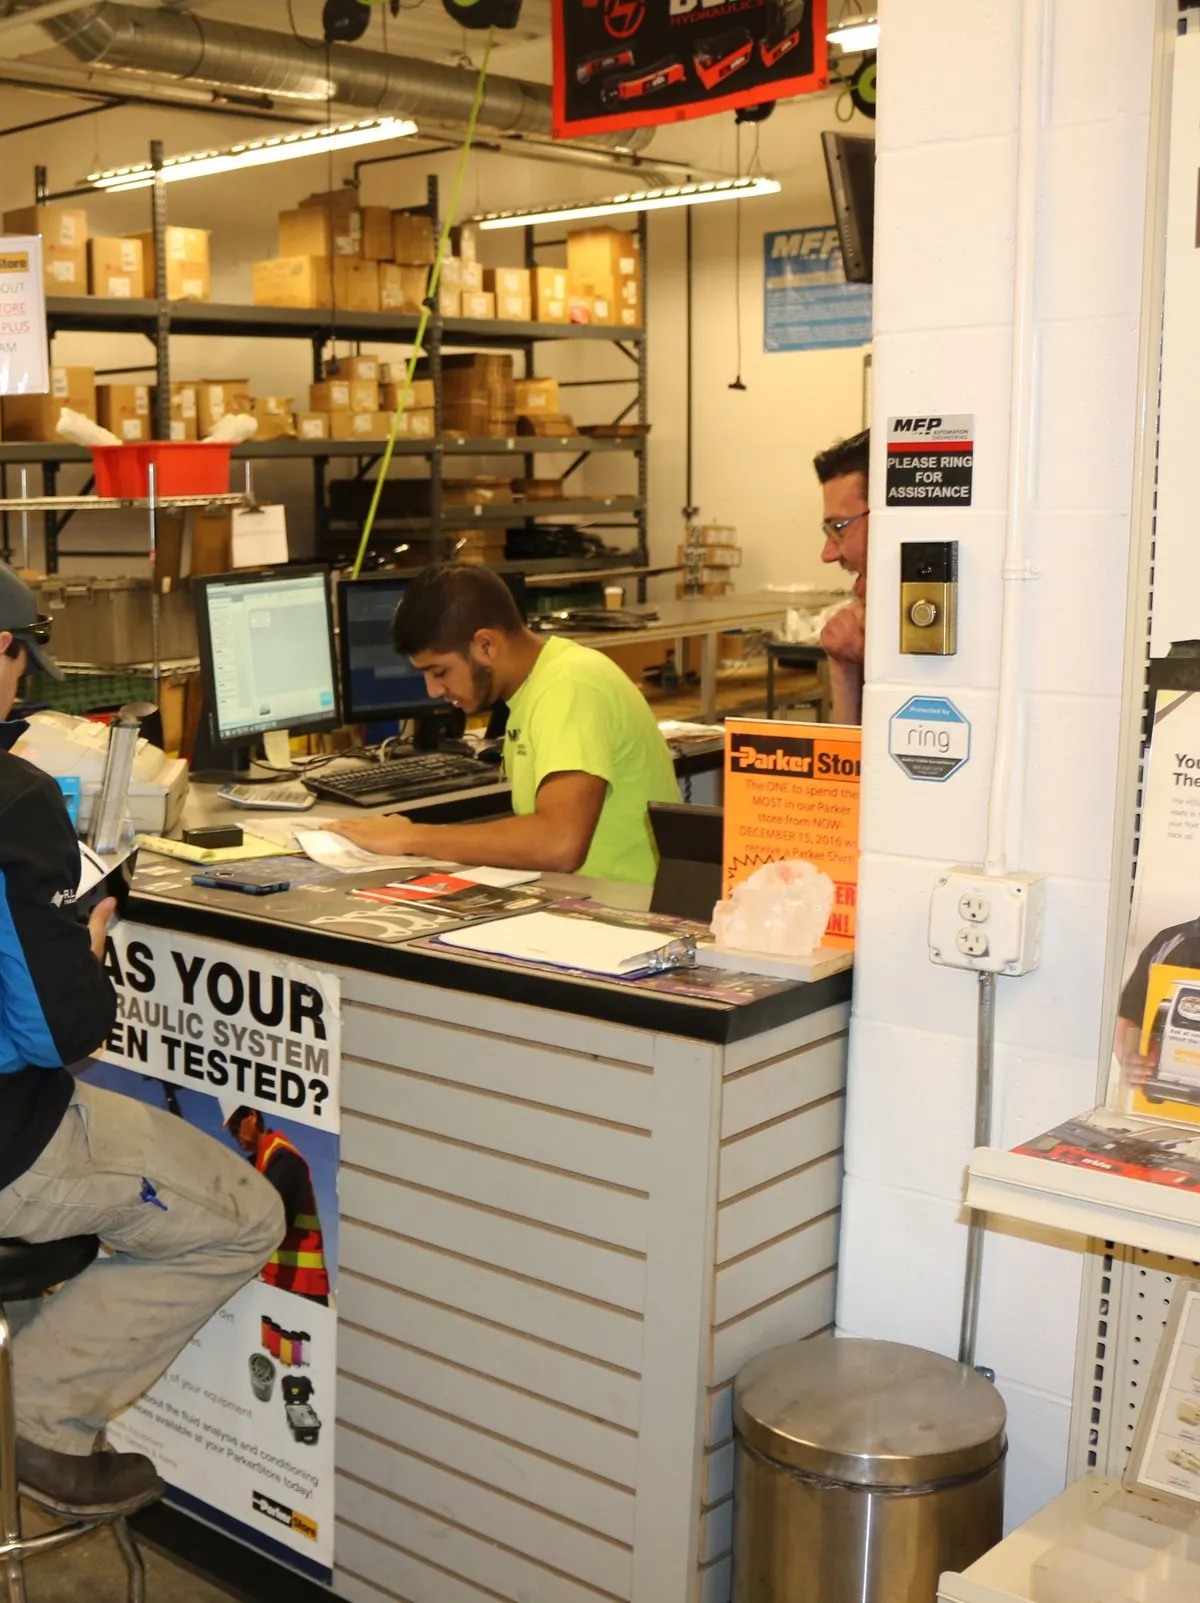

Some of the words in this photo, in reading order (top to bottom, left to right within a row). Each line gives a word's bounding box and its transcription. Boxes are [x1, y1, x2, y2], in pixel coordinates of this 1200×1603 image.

[2, 320, 30, 333] PLUS
[893, 418, 942, 432] MFP
[887, 457, 938, 469] PLEASE
[940, 456, 973, 468] RING
[915, 471, 943, 483] FOR
[888, 486, 970, 498] ASSISTANCE
[907, 724, 950, 753] ring
[731, 746, 812, 773] Parker
[746, 779, 764, 790] The
[766, 781, 789, 793] ONE
[792, 784, 803, 795] to
[806, 787, 838, 799] spend
[752, 796, 782, 808] MOST
[785, 801, 795, 810] in
[797, 803, 815, 812] our
[818, 802, 851, 815] Parker
[758, 813, 783, 824] store
[786, 813, 811, 827] from
[739, 825, 796, 842] DECEMBER
[816, 834, 842, 847] 2016
[793, 847, 825, 861] Parker
[104, 935, 156, 993] AS
[171, 951, 327, 1041] YOUR
[116, 993, 204, 1040] RAULIC
[213, 1020, 329, 1077] SYSTEM
[107, 1021, 148, 1063] EN
[161, 1035, 329, 1116] TESTED?
[170, 1373, 180, 1384] of
[181, 1379, 202, 1395] your
[203, 1389, 252, 1418] equipment
[154, 1412, 193, 1439] available
[194, 1432, 203, 1444] at
[205, 1439, 225, 1454] your
[227, 1447, 282, 1483] ParkerStore
[165, 1401, 180, 1417] the
[181, 1409, 200, 1428] fluid
[202, 1421, 238, 1446] analysis
[240, 1440, 258, 1456] and
[260, 1449, 319, 1488] conditioning
[259, 1498, 292, 1526] Parker
[294, 1516, 318, 1538] Store
